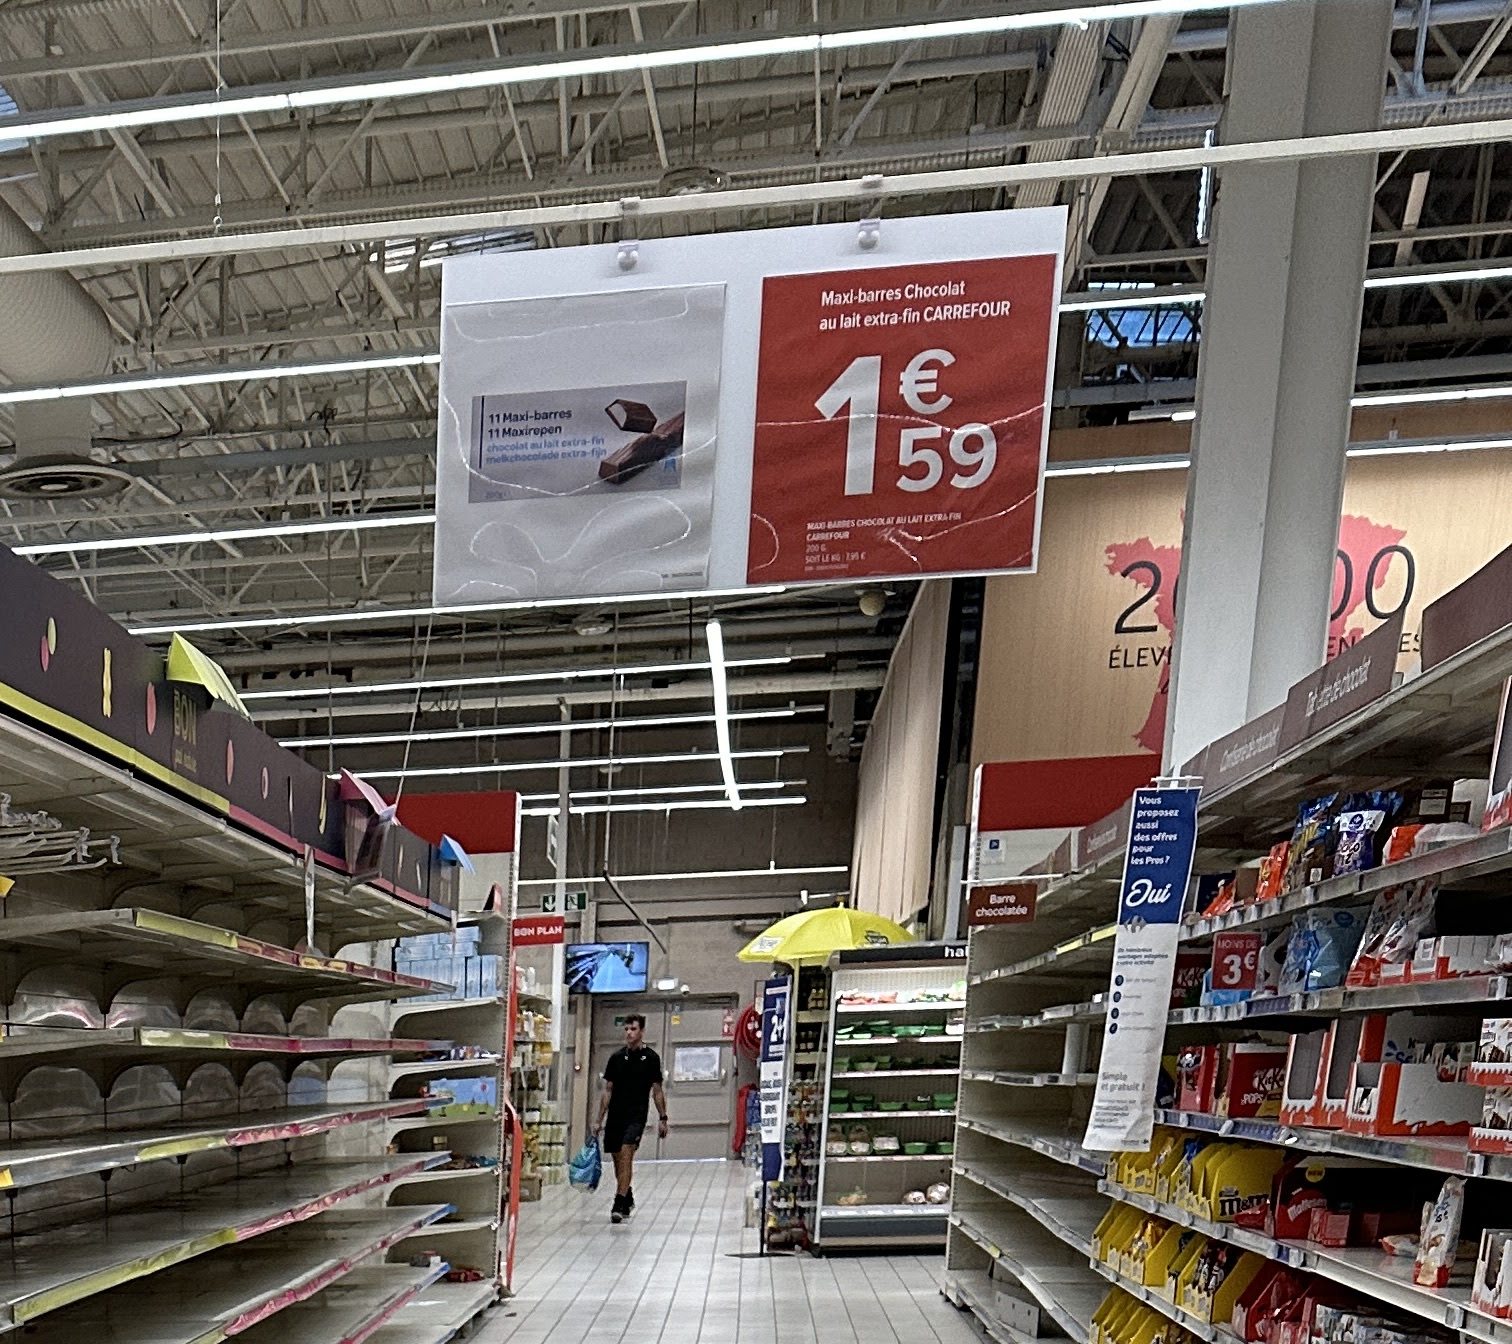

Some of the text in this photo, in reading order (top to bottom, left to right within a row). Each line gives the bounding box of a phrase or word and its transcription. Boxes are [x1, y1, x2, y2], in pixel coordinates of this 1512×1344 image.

[821, 280, 966, 306] Maxi-barres Chocolat
[819, 300, 1011, 330] au lait extra-fin CARREFOUR
[489, 408, 572, 424] 11 Maxi-barres
[814, 349, 956, 496] 1 €
[488, 428, 500, 439] 11
[488, 439, 529, 453] chocolat
[896, 422, 998, 493] 59
[1139, 796, 1162, 805] Vous
[1137, 809, 1179, 819] proposez
[1135, 820, 1159, 829] aussi
[1133, 832, 1178, 841] des offres
[1132, 845, 1154, 854] pour
[1130, 856, 1144, 865] les
[1125, 878, 1172, 908] Oui
[989, 894, 1016, 905] Barre
[975, 904, 1028, 917] chocolatée
[514, 925, 563, 937] BON PLAN
[1222, 954, 1242, 985] 3
